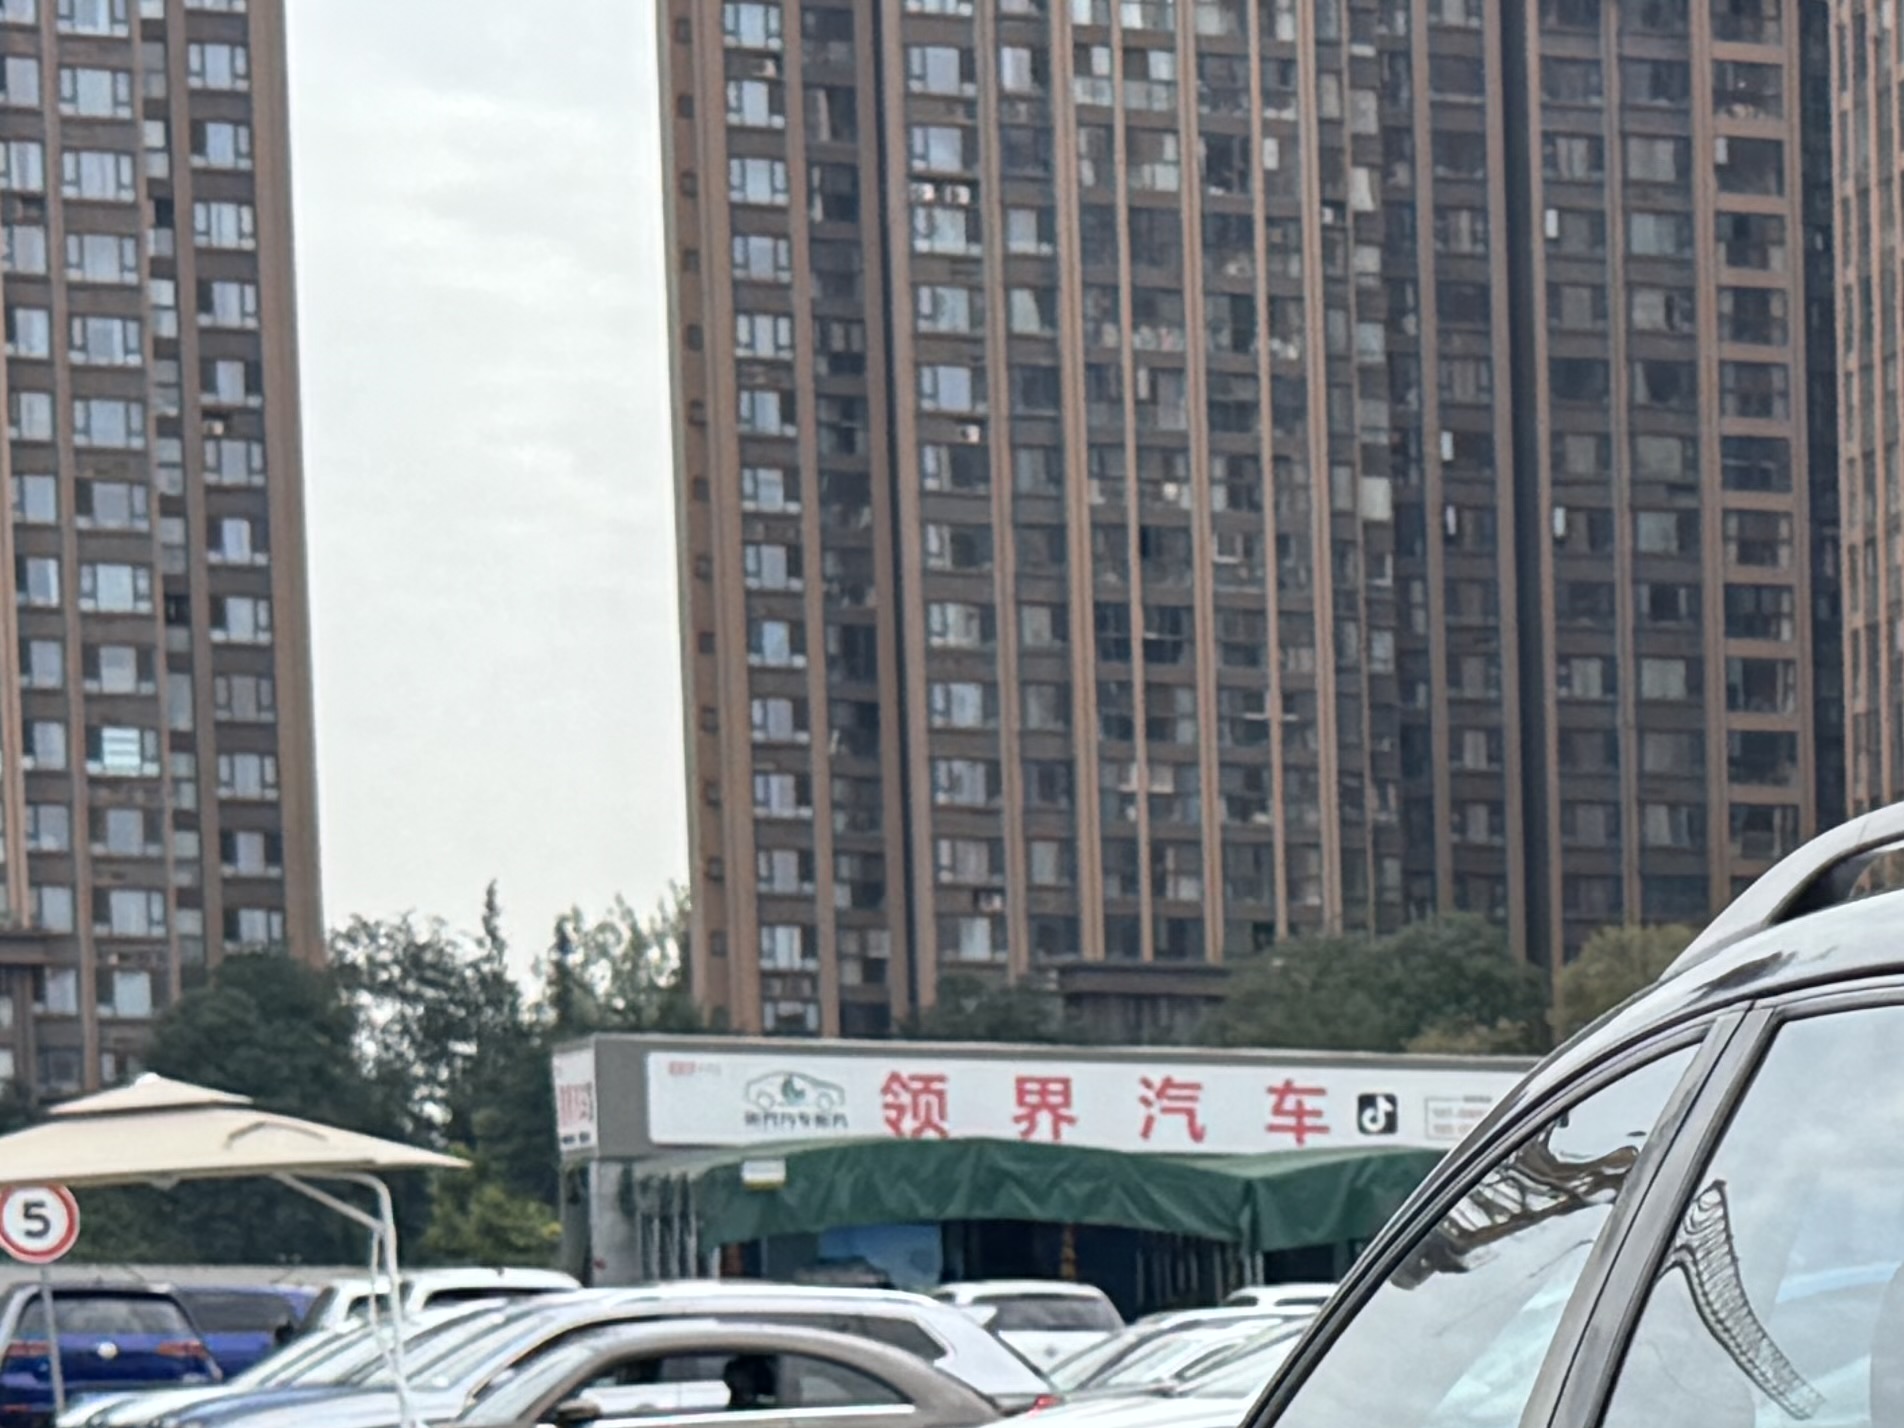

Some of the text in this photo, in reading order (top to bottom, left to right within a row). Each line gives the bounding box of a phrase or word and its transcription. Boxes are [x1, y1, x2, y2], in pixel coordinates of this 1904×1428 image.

[880, 1070, 1331, 1146] 领界汽车
[23, 1200, 51, 1239] 5
